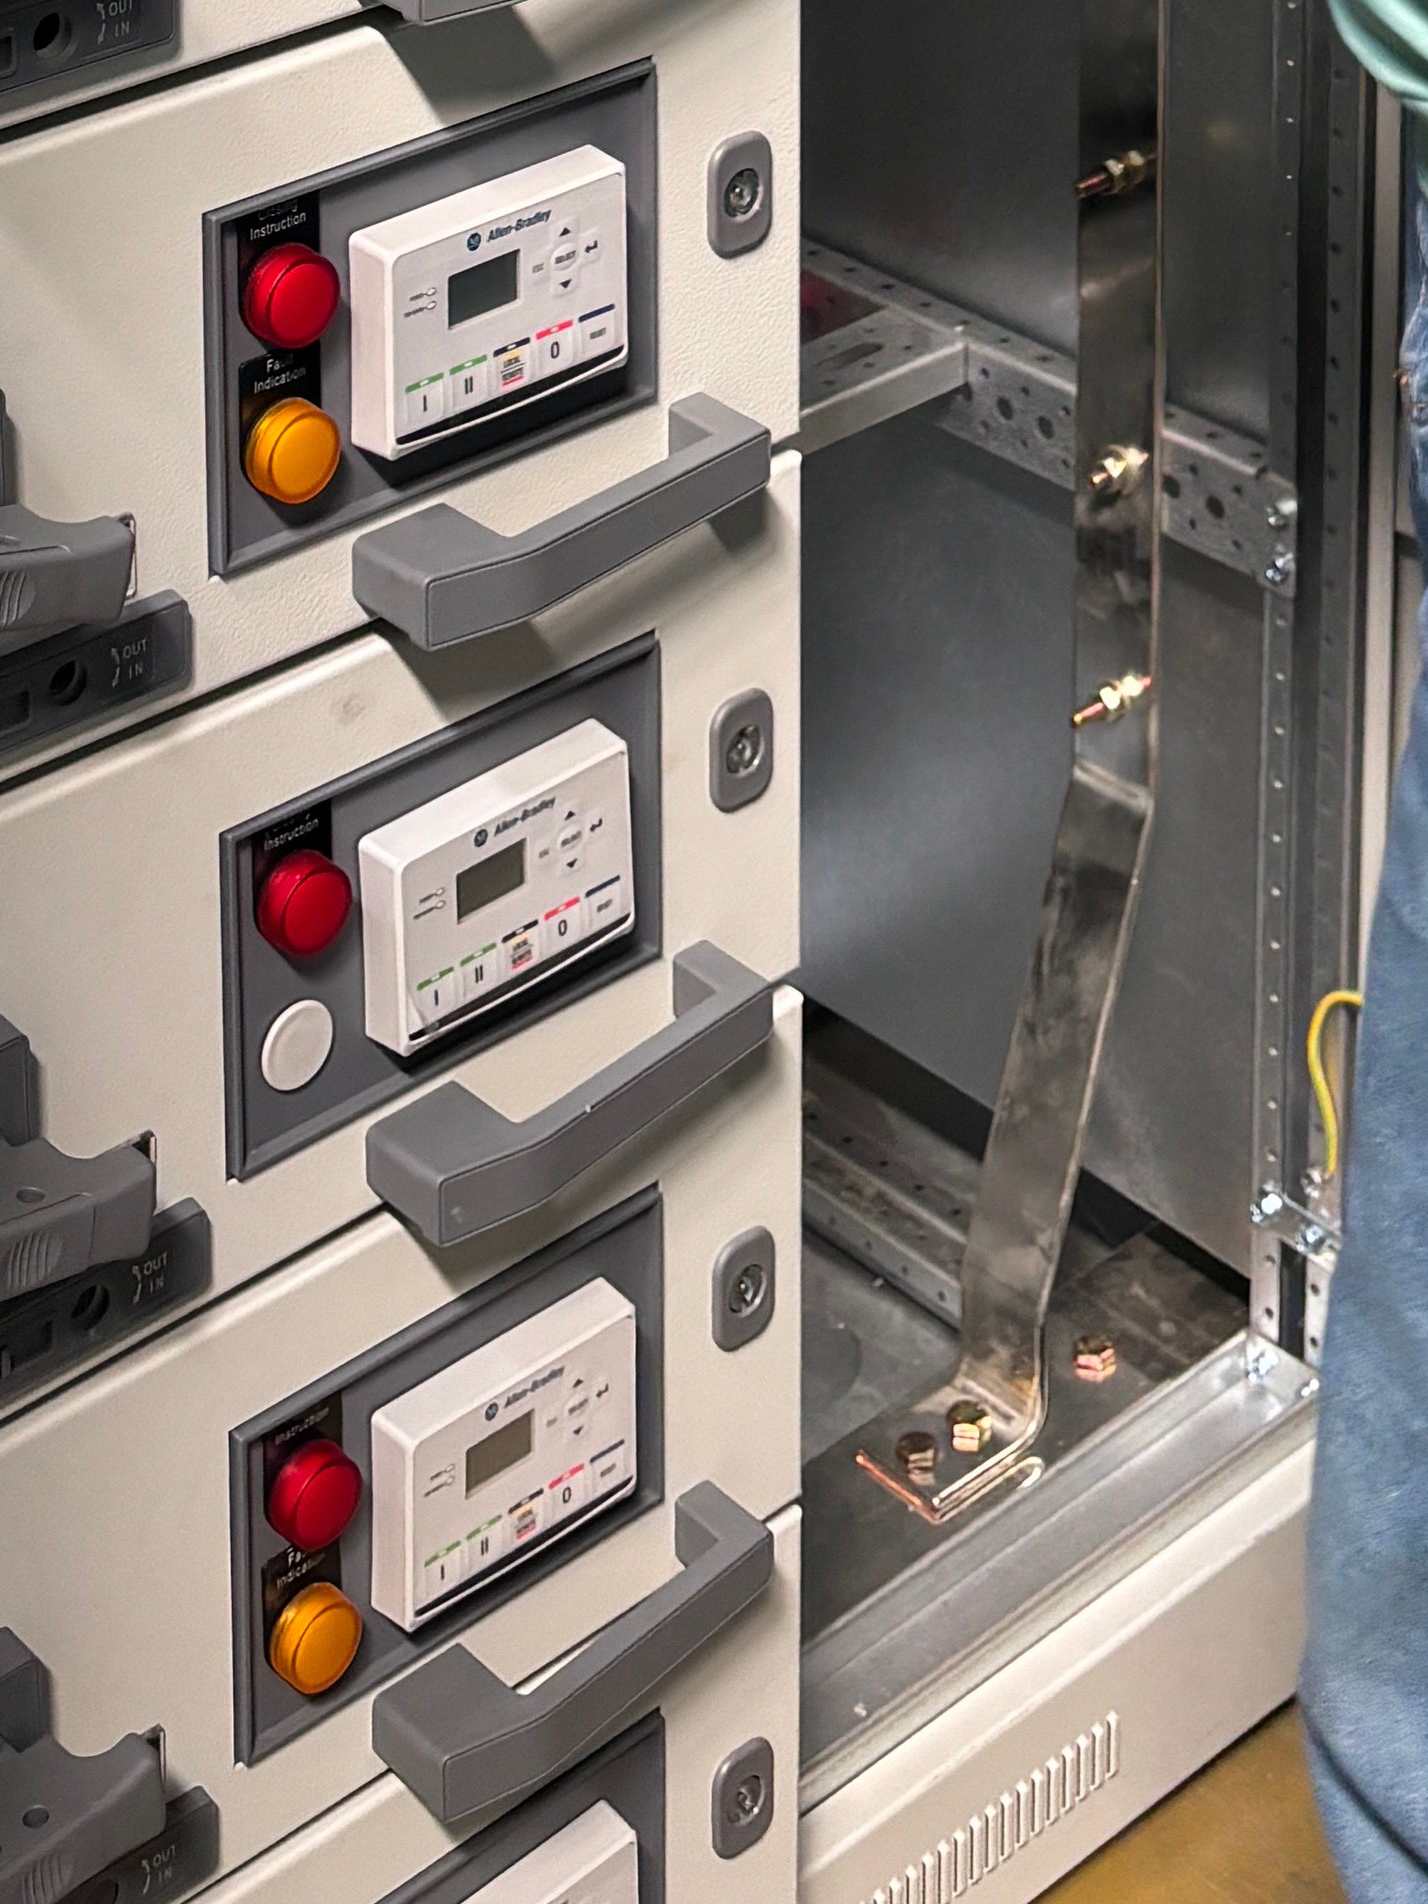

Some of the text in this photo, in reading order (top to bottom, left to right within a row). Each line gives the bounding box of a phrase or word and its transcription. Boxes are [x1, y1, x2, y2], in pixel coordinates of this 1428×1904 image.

[114, 21, 130, 37] IN
[250, 211, 307, 241] Instruction
[487, 209, 553, 243] Allen-Bradley
[253, 364, 307, 394] Indication
[122, 639, 148, 659] OUT
[127, 664, 144, 681] IN
[494, 796, 557, 838] Allen-Bradley
[263, 815, 320, 850] Instruction
[143, 1253, 169, 1276] OUT
[149, 1274, 164, 1294] IN
[152, 1845, 176, 1866] OUT
